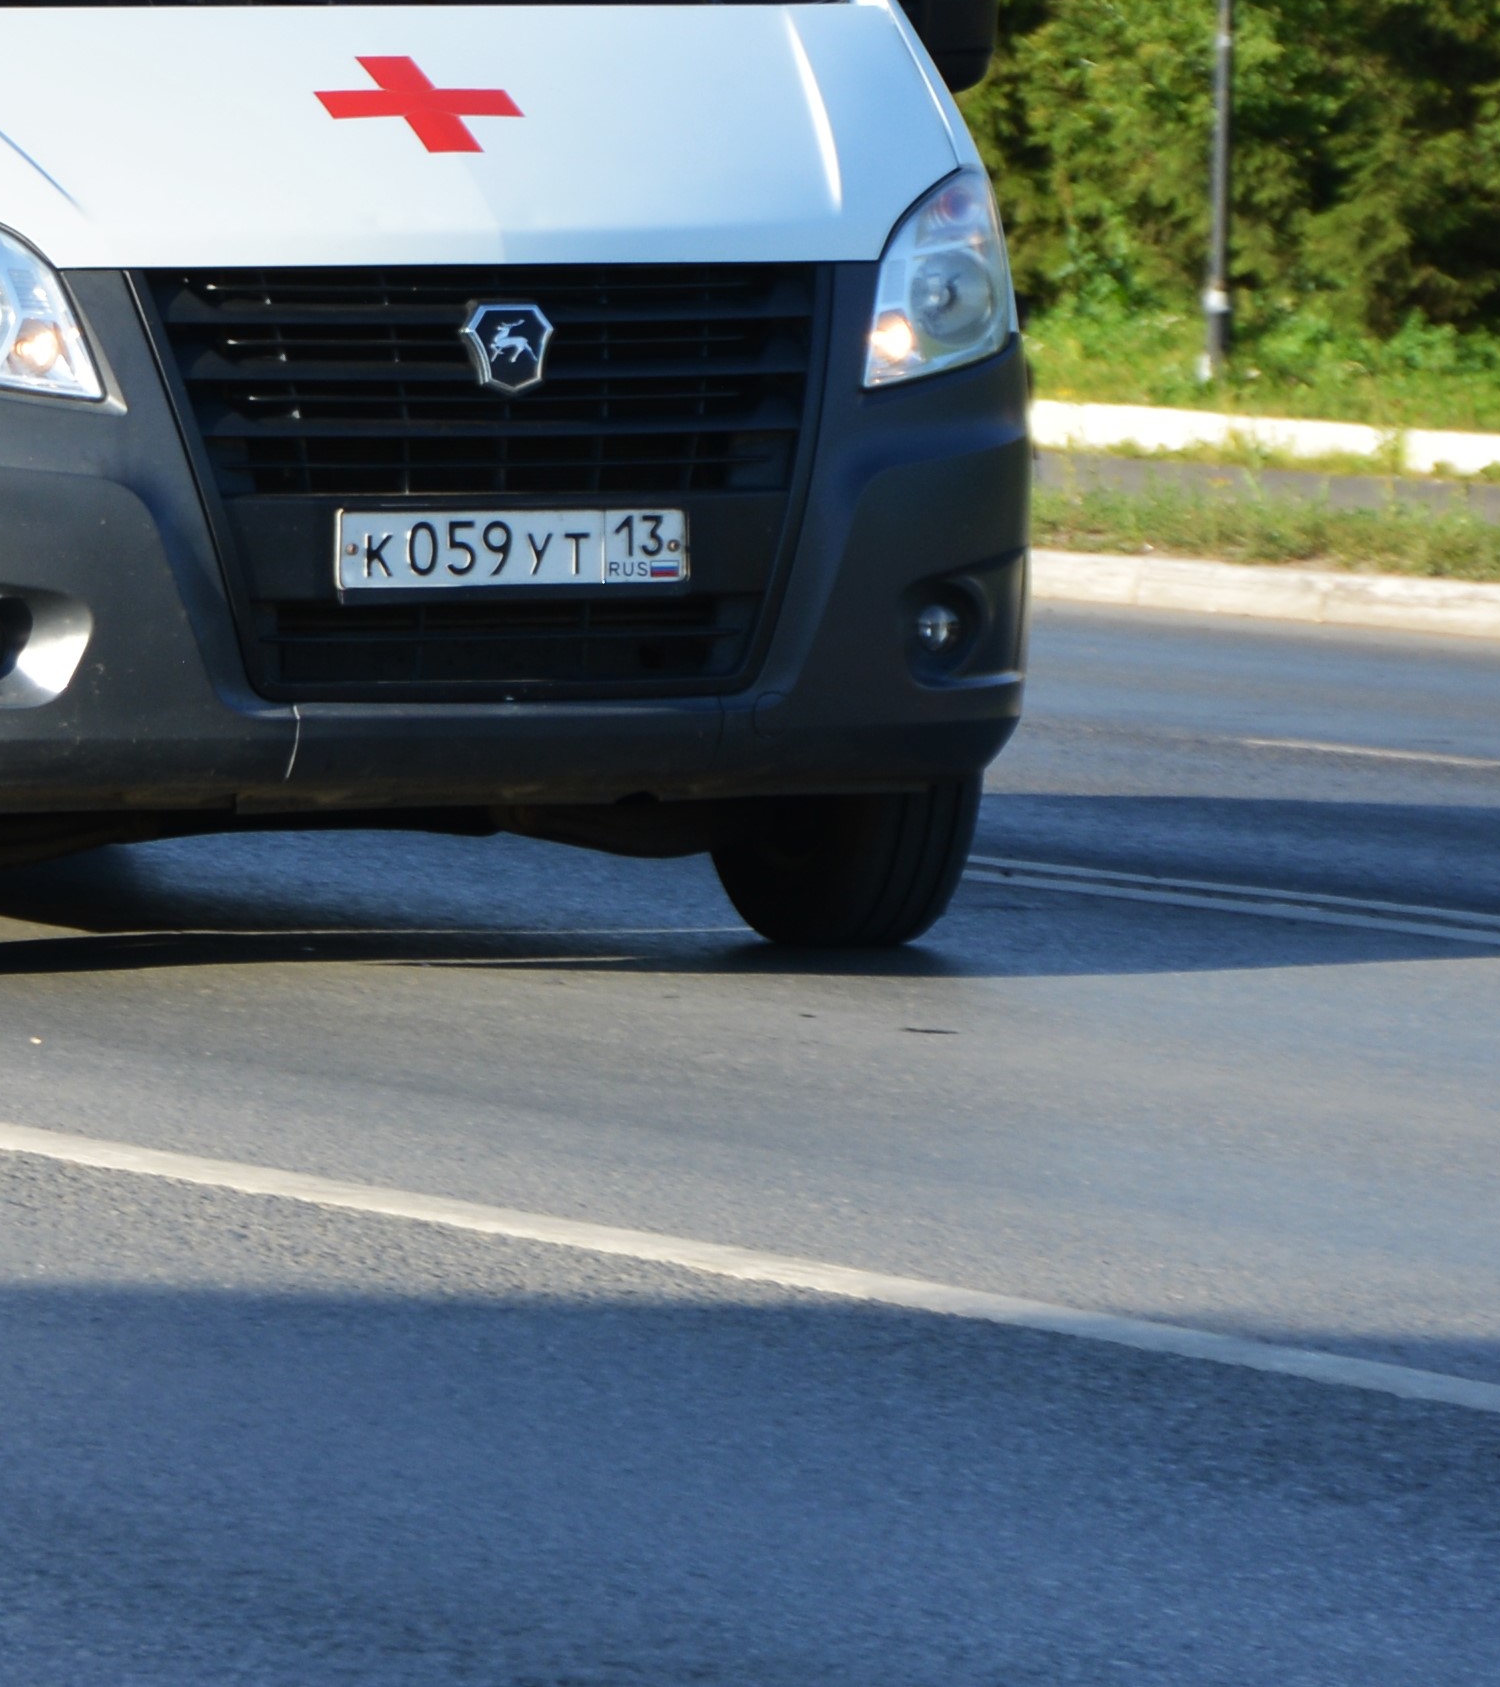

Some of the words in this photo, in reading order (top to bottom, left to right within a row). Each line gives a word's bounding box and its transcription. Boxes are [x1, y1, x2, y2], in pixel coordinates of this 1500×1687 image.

[363, 520, 591, 578] К059УТ
[613, 514, 665, 558] 13
[608, 561, 649, 577] RUS
